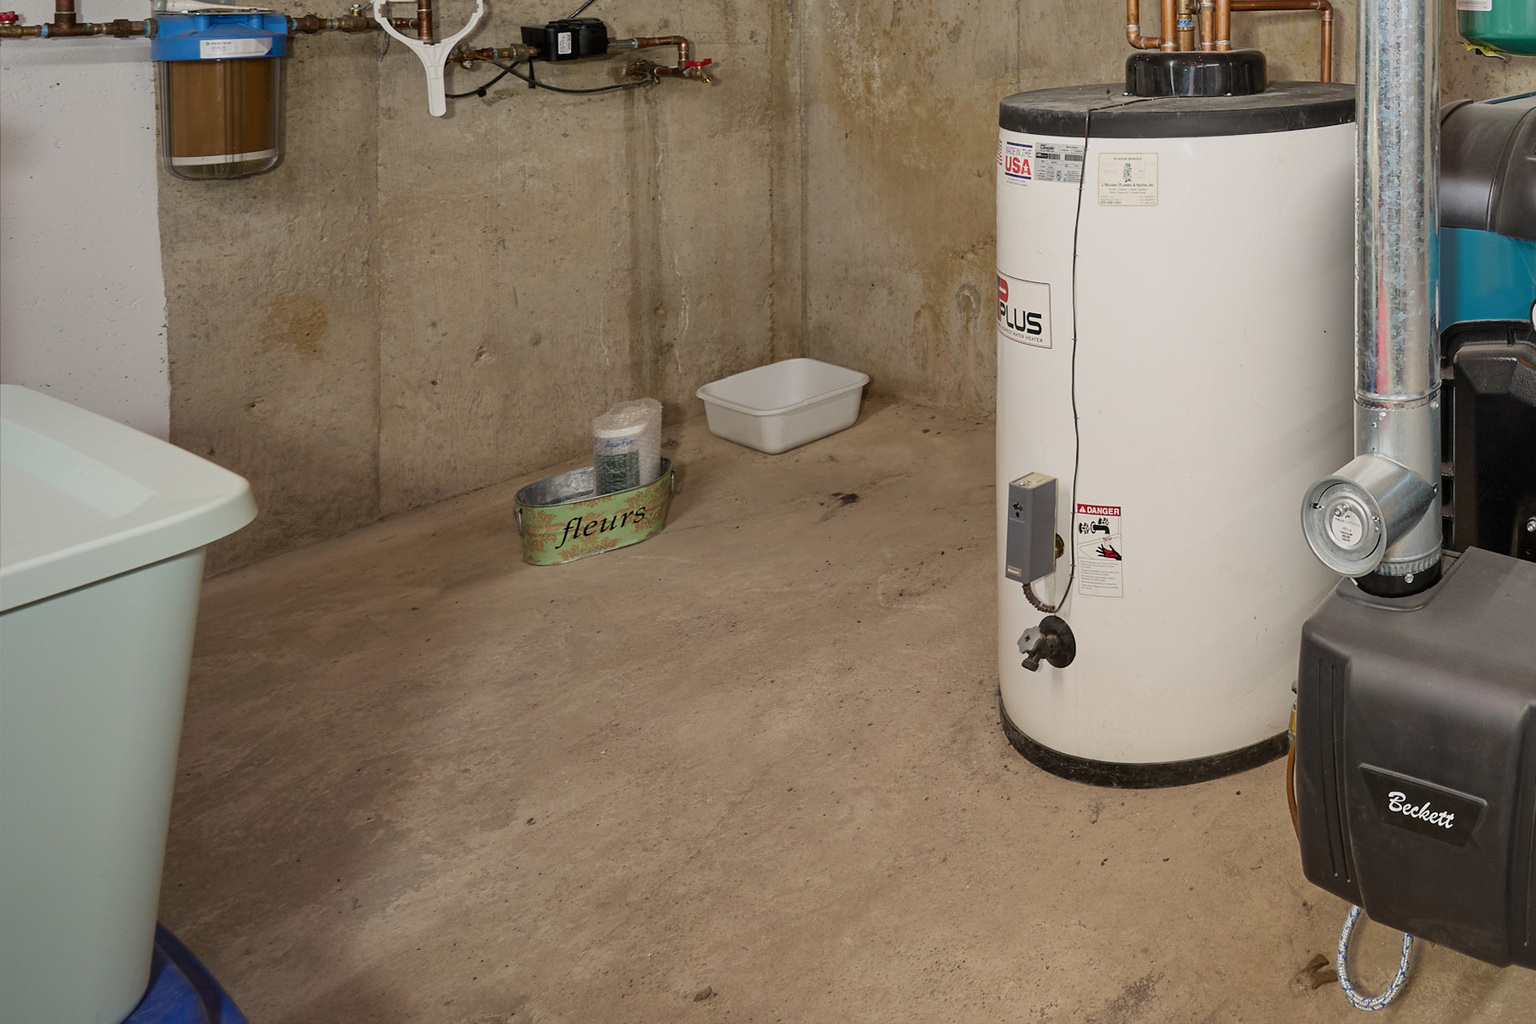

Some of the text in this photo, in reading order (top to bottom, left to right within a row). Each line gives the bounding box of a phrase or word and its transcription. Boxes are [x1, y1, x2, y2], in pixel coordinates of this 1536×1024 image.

[1005, 155, 1032, 175] USA
[1000, 301, 1042, 336] PLUS
[555, 506, 646, 549] fleurs
[1086, 506, 1120, 516] DANGER
[1388, 791, 1455, 829] Beckett
